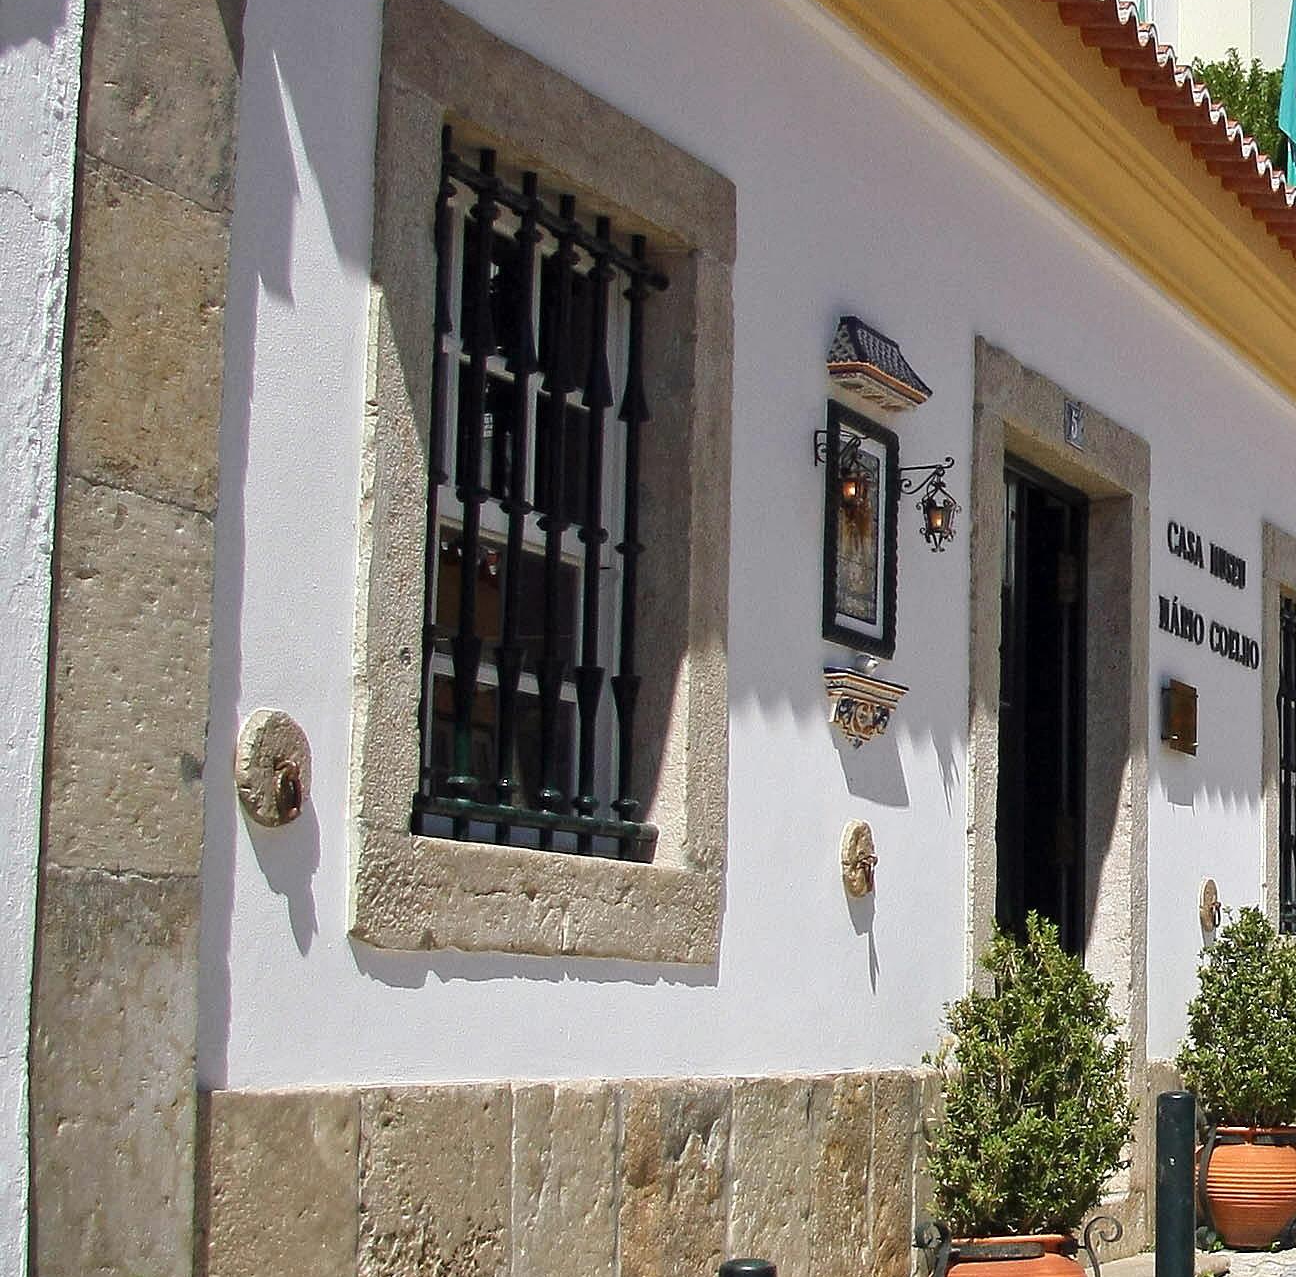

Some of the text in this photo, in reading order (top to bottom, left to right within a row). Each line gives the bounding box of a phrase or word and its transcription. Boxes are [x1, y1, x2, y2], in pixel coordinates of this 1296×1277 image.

[1167, 520, 1246, 590] CASA MUSEU
[1158, 594, 1259, 669] MÁRIO COELHO
